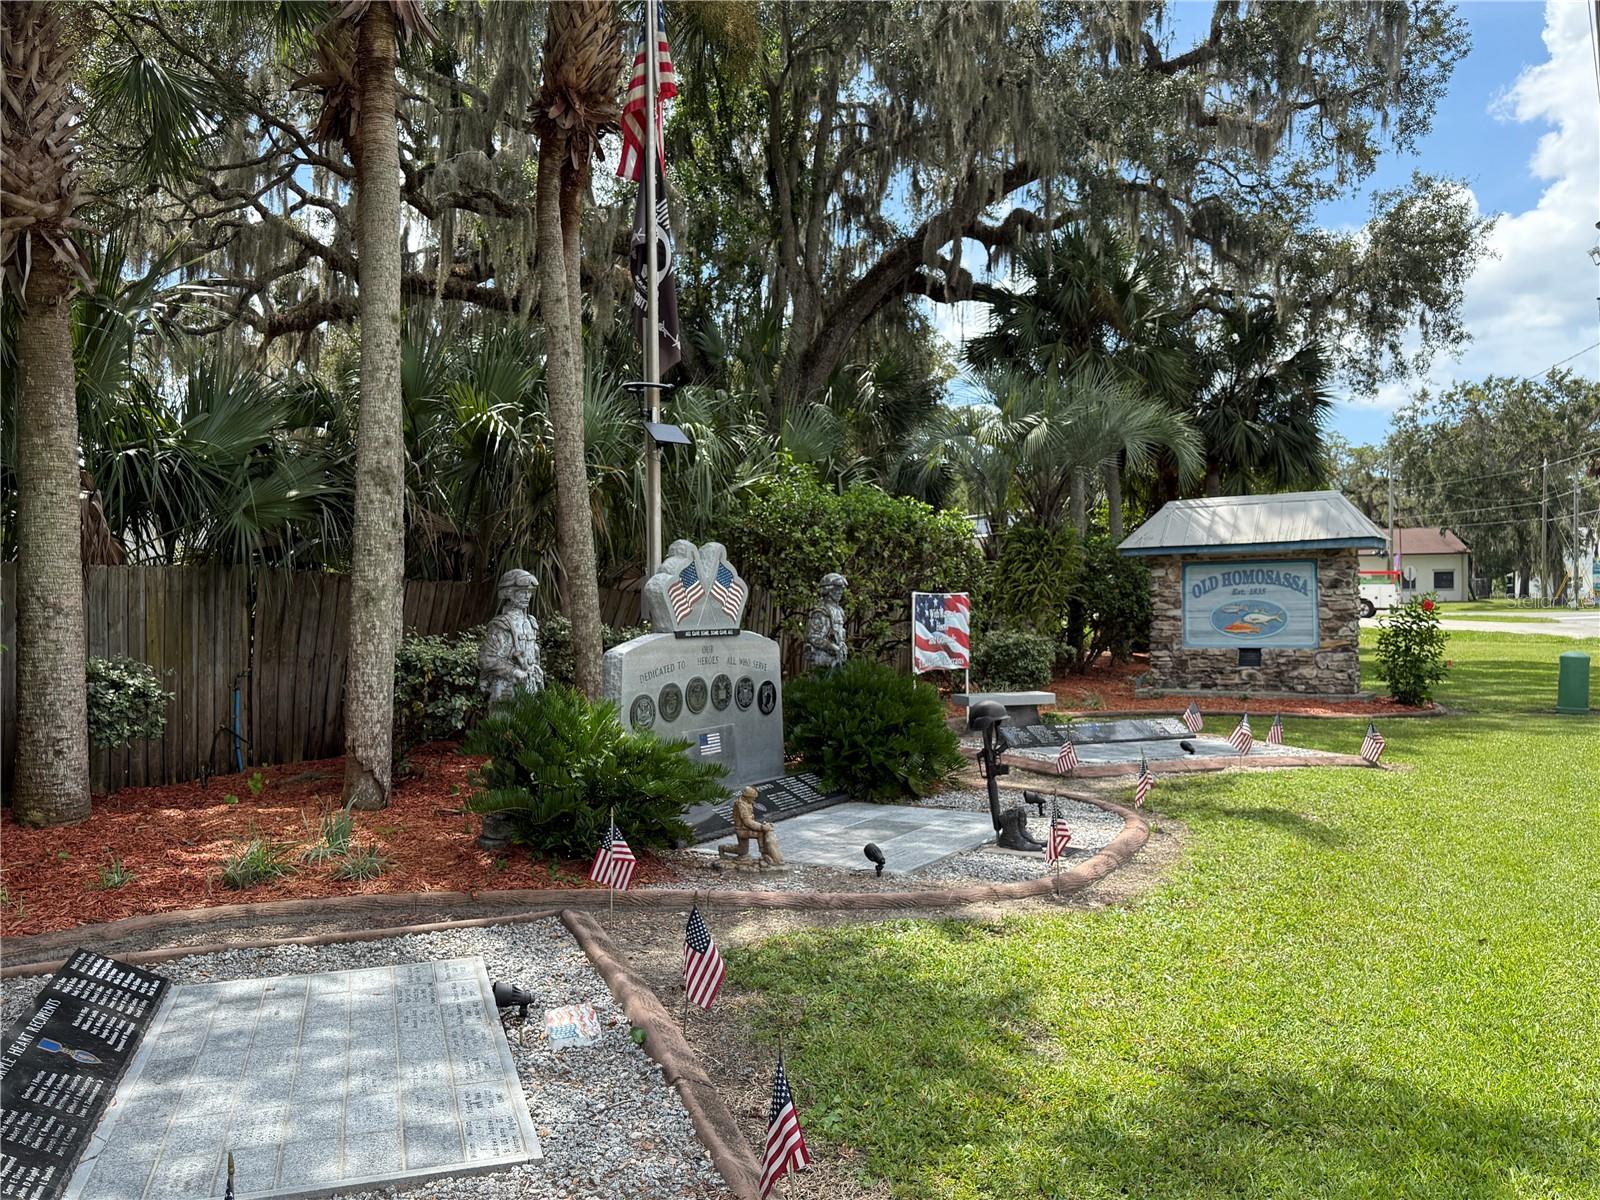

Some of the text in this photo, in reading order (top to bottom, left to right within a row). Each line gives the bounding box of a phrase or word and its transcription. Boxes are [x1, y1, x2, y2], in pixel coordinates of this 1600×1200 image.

[1192, 568, 1309, 598] OLD HOMOSASSA
[639, 663, 675, 684] DEDICATED
[677, 660, 686, 670] TO
[697, 655, 720, 666] HEROES
[727, 656, 737, 665] ALL
[752, 660, 768, 671] SERVE
[0, 999, 60, 1080] RPLE HEART RECIPIENTS
[2, 1184, 14, 1195] Sam
[12, 1166, 26, 1179] Dixon
[16, 1187, 28, 1200] John
[26, 1167, 39, 1181] Bright
